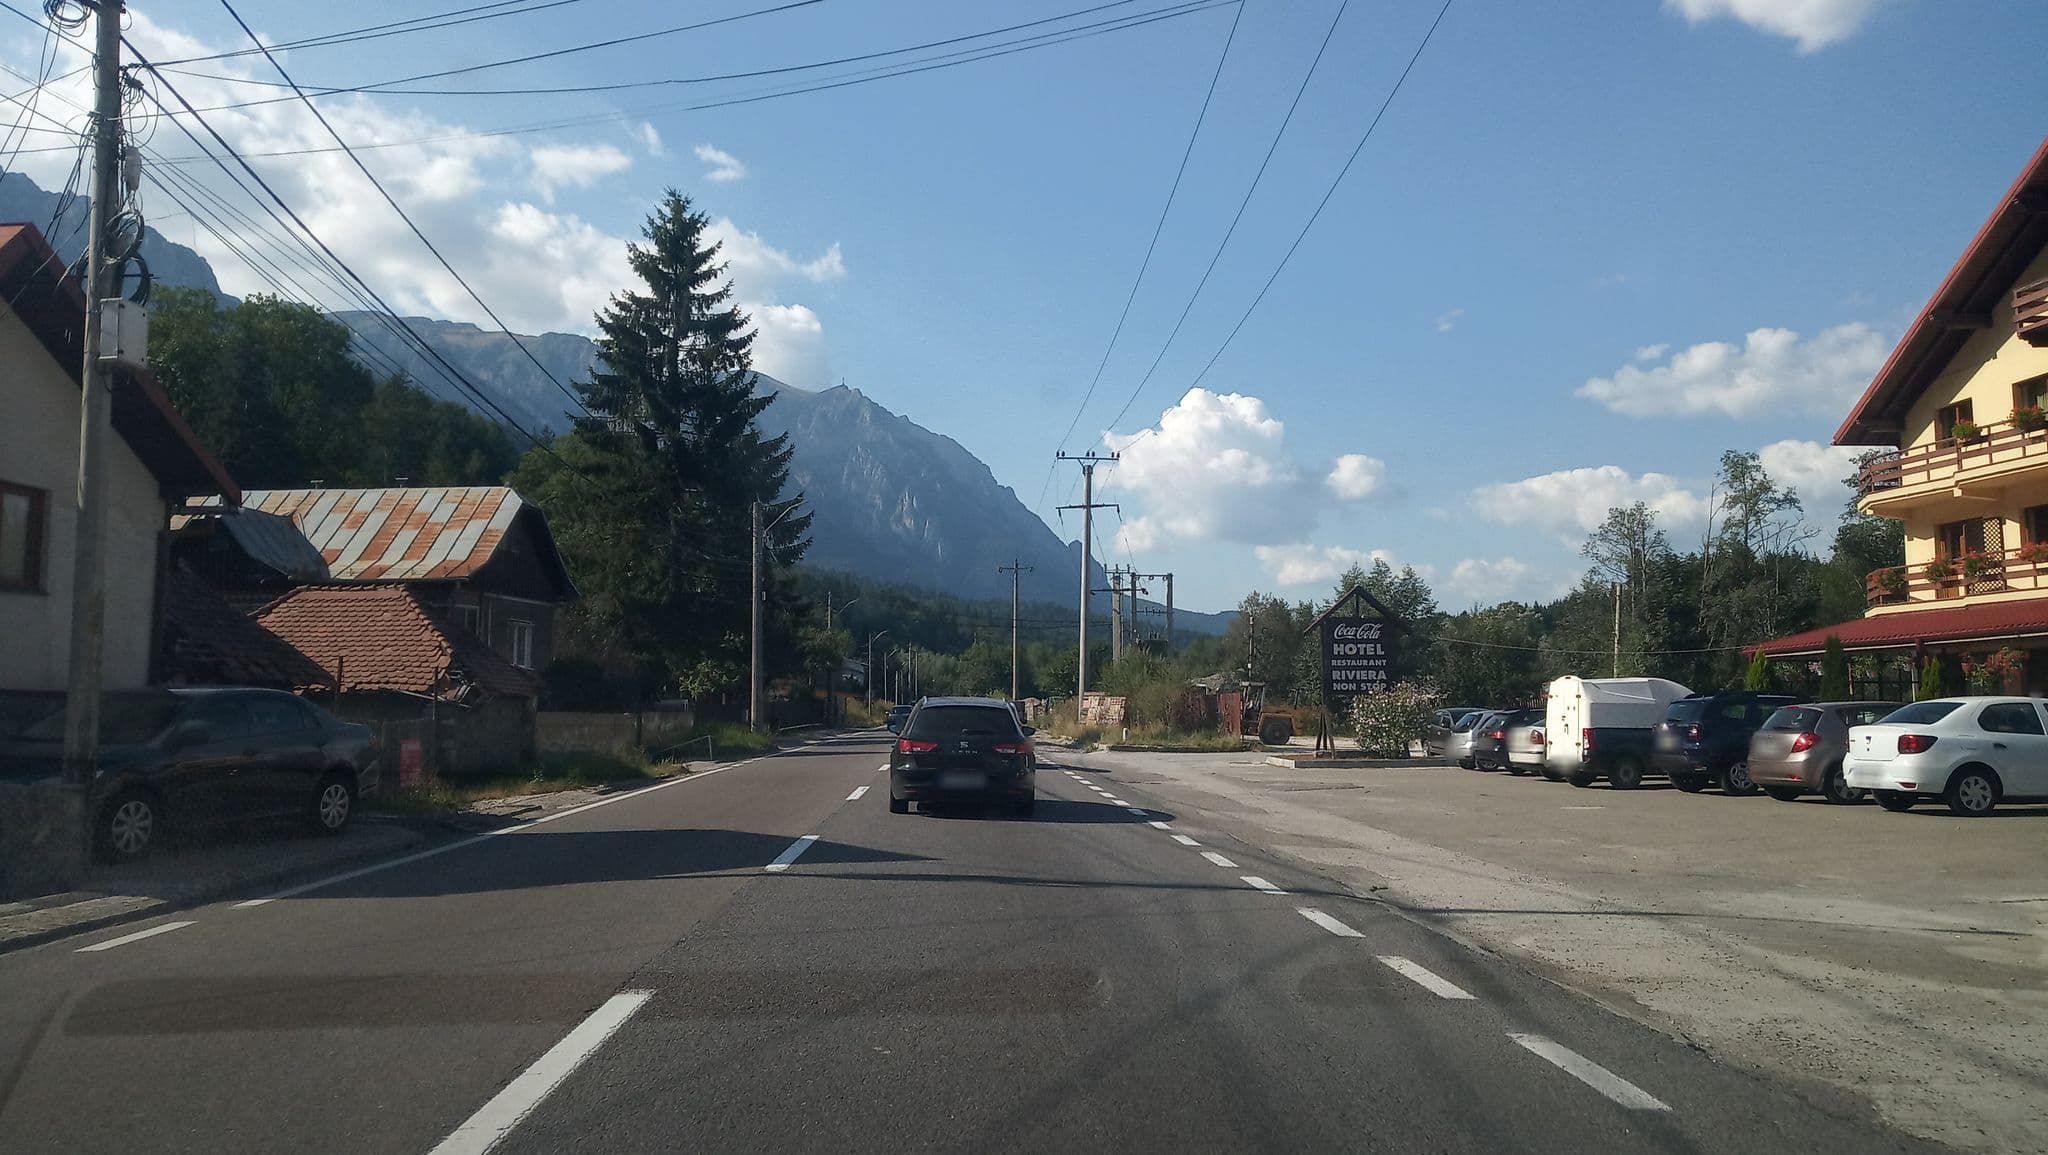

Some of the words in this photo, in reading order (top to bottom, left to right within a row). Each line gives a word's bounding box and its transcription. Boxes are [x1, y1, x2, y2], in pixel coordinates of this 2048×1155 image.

[1333, 623, 1383, 640] Coca-Cola
[1333, 643, 1385, 656] HOTEL
[1332, 670, 1387, 680] RIVIERA
[1333, 682, 1356, 691] NON
[1360, 682, 1387, 691] STOP
